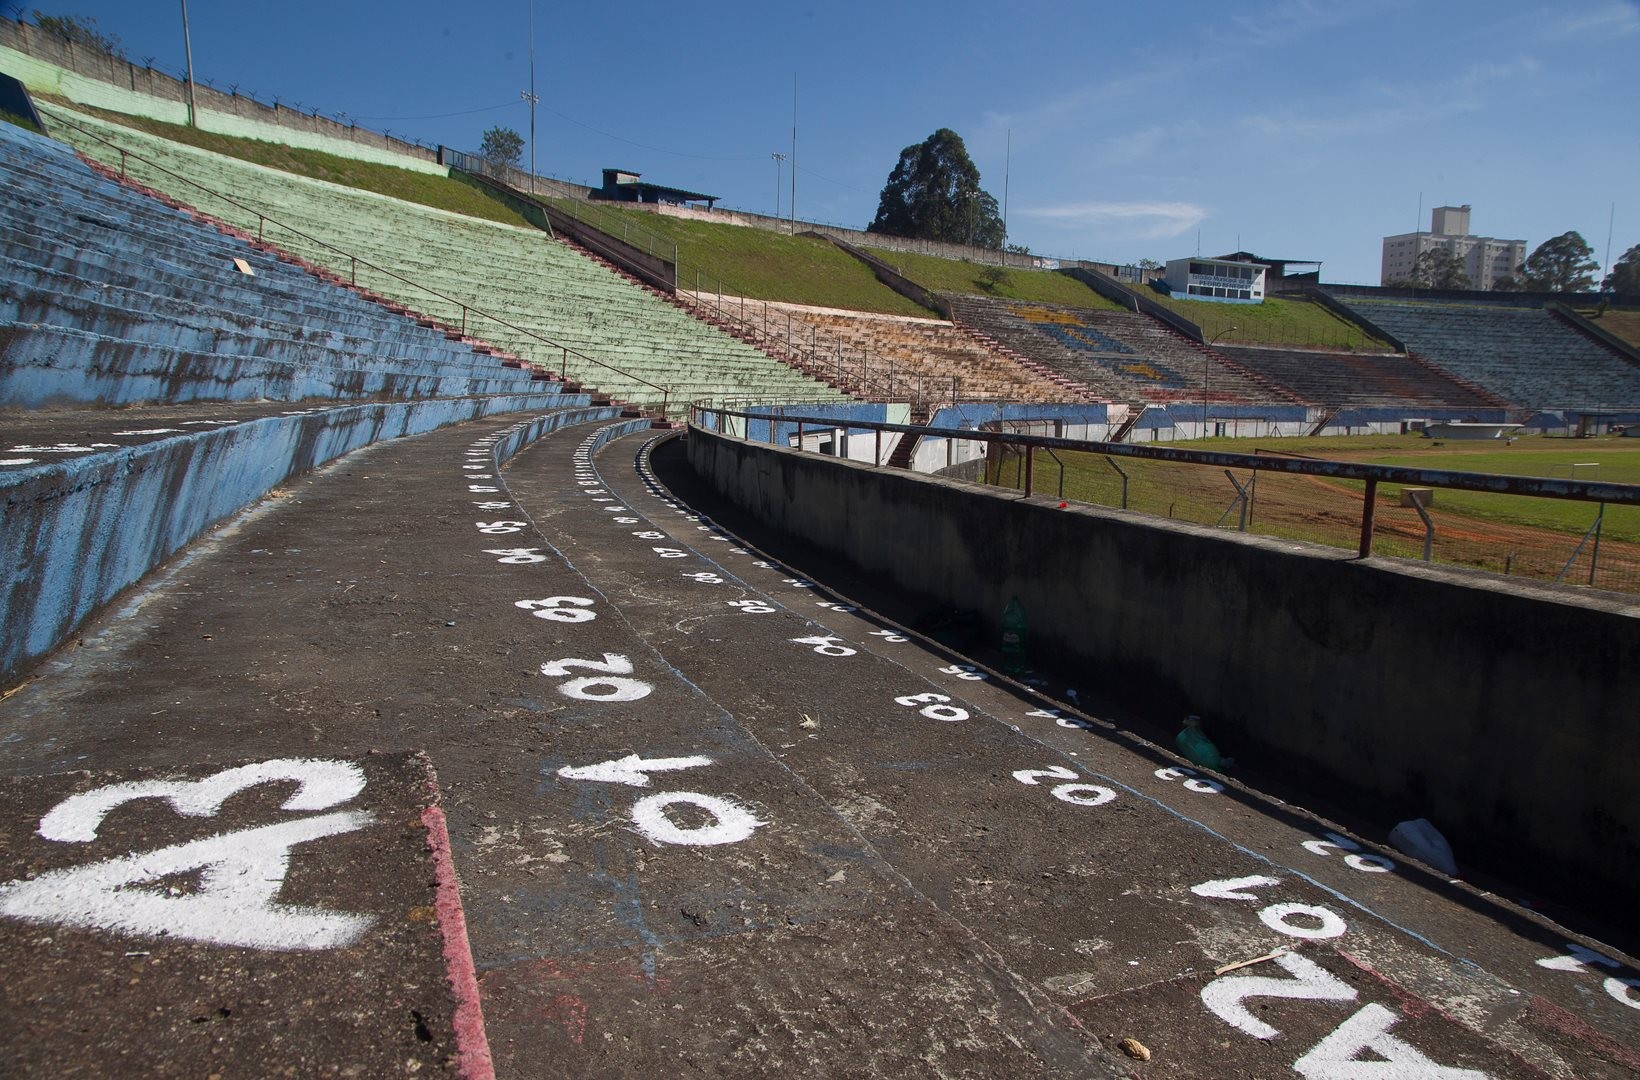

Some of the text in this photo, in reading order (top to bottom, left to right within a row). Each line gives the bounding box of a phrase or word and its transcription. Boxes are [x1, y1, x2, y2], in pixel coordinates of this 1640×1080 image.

[475, 521, 527, 534] 05
[632, 531, 665, 539] 08
[481, 547, 549, 564] 04
[652, 547, 688, 558] 07
[682, 572, 723, 584] 06
[515, 596, 597, 623] 03
[727, 600, 776, 614] 05
[816, 602, 857, 613] 07
[788, 636, 857, 657] 04
[868, 629, 911, 643] 06
[541, 653, 655, 702] 02
[938, 664, 988, 681] 05
[894, 693, 970, 722] 03
[1025, 709, 1093, 729] 04
[1012, 765, 1117, 806] 02
[1154, 766, 1226, 794] 03
[557, 754, 764, 847] 01
[0, 756, 378, 952] A3
[1301, 832, 1397, 873] 02
[1190, 874, 1347, 940] 01
[1200, 946, 1496, 1080] A2
